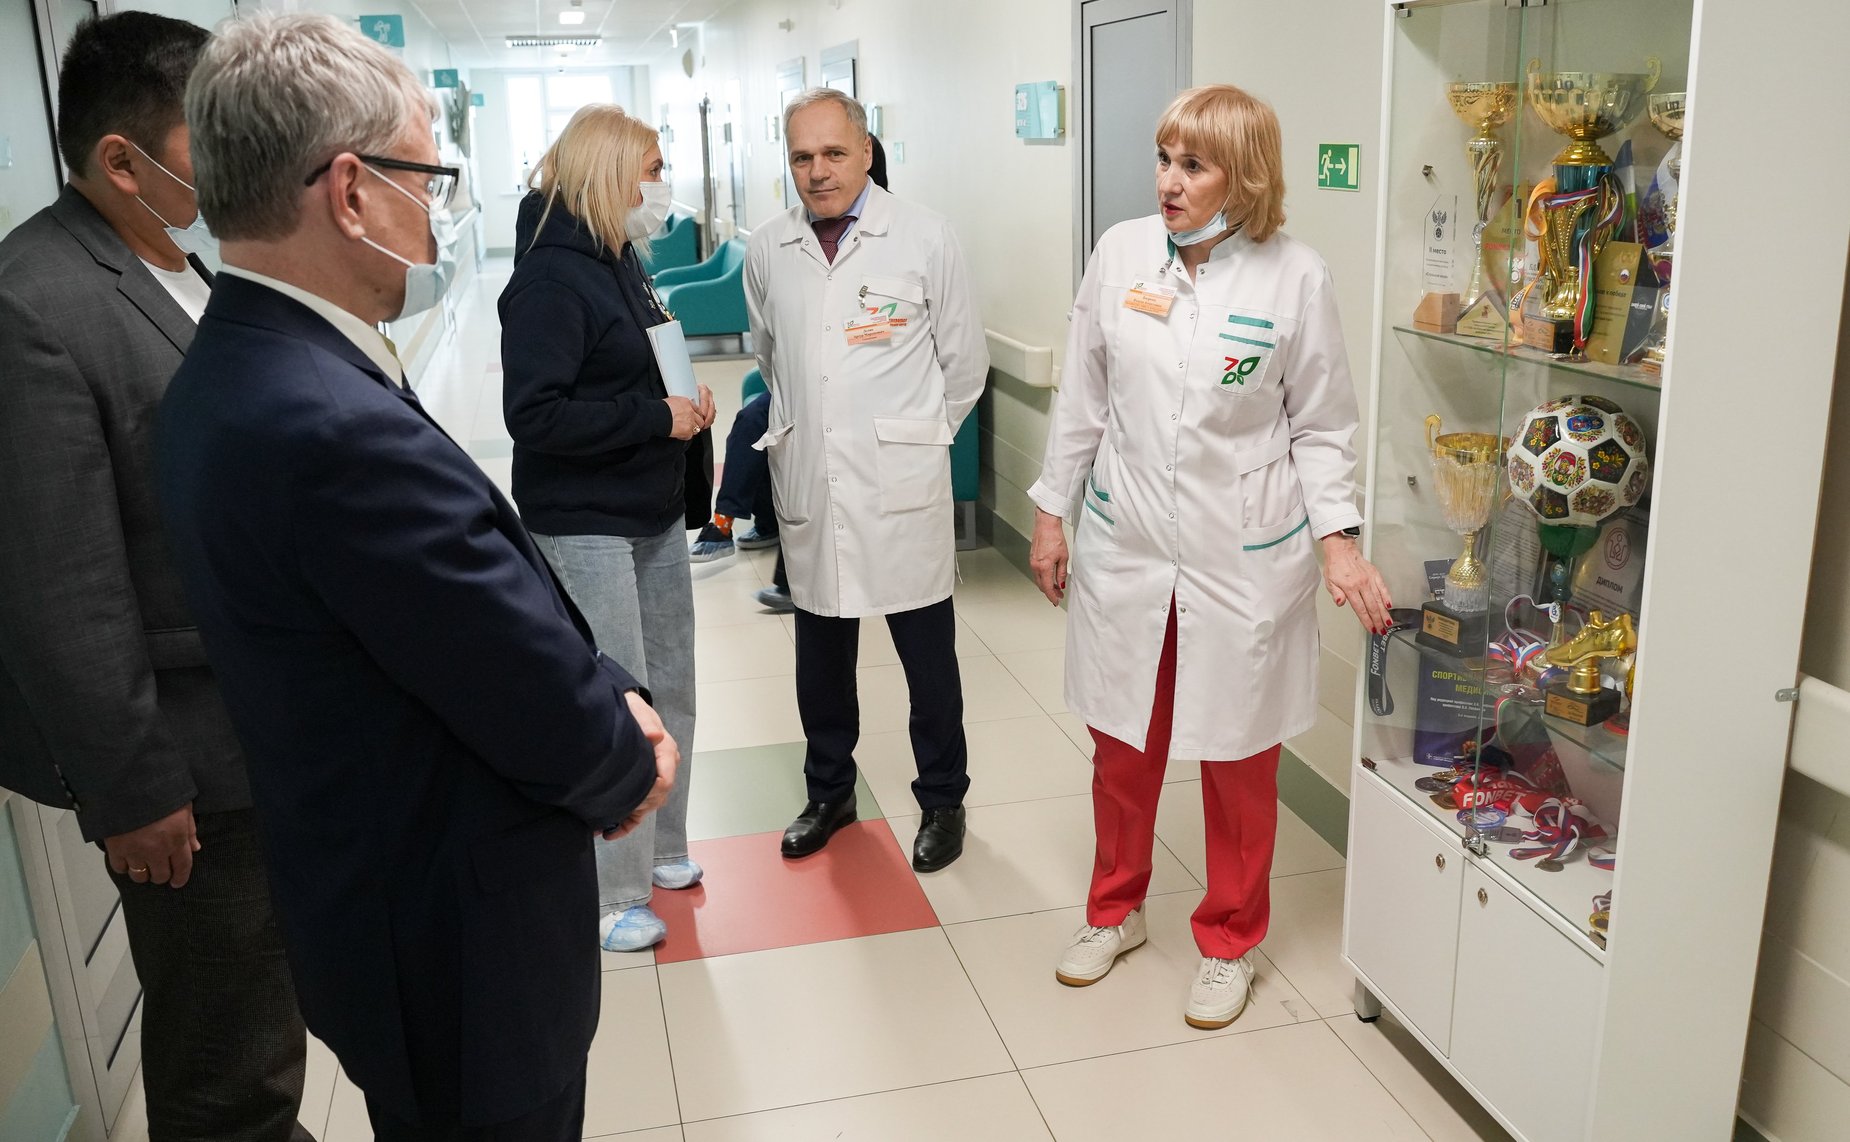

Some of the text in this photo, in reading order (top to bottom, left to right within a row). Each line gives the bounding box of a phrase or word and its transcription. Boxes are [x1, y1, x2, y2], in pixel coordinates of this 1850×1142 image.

[1596, 576, 1624, 594] ДИПЛОМ
[1370, 641, 1380, 676] FONBET
[1431, 670, 1467, 682] СПОРТИ
[1462, 789, 1527, 807] FONBET
